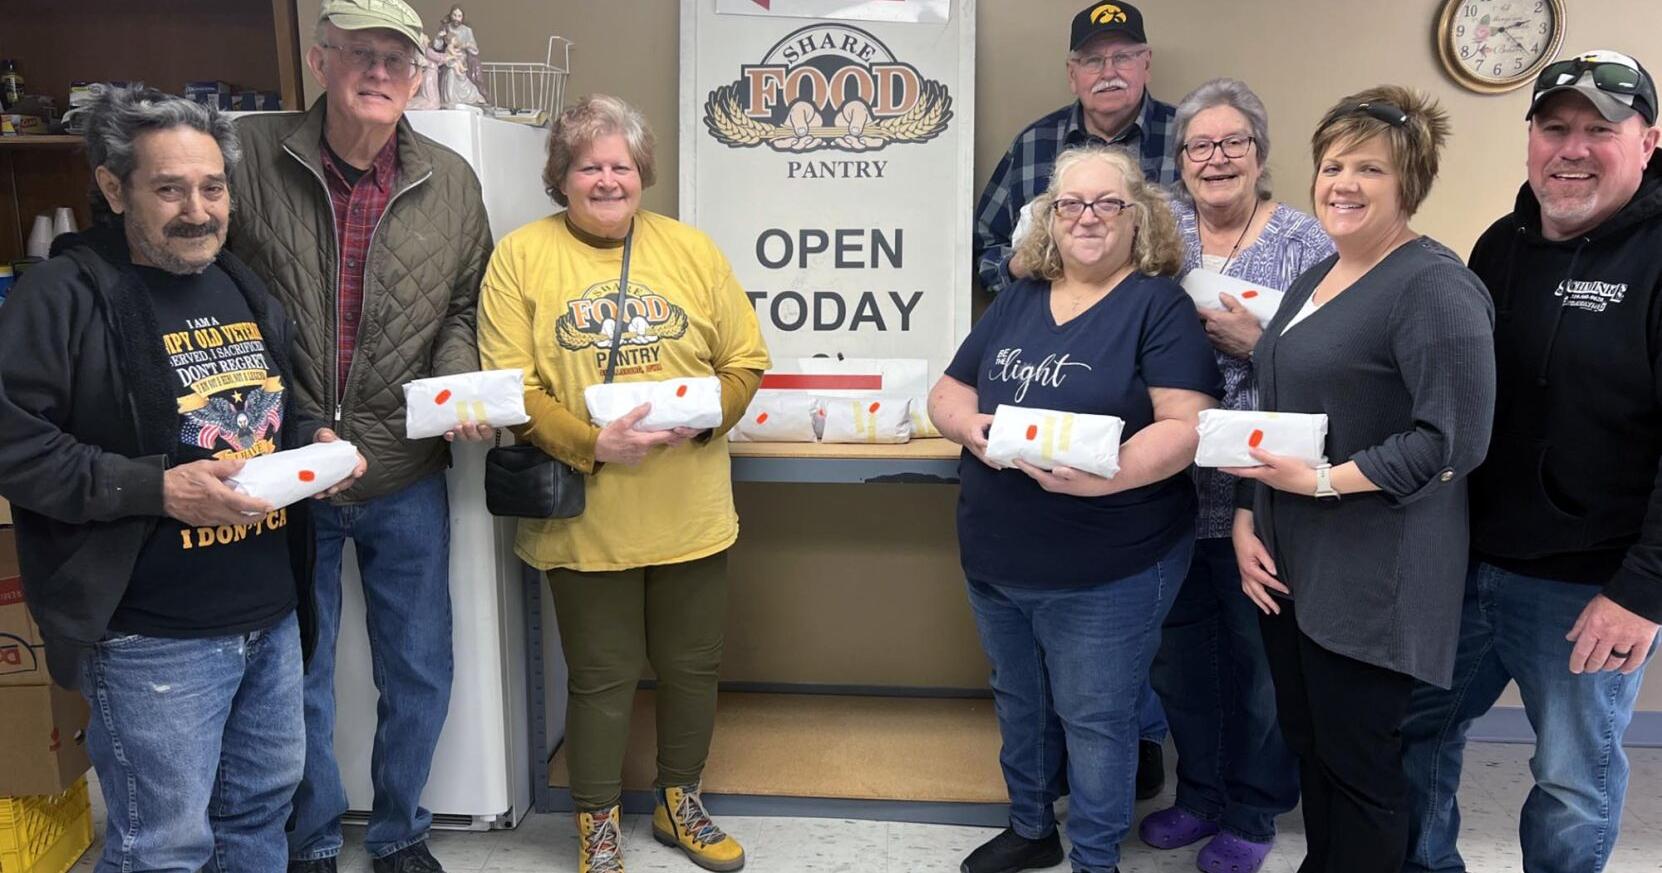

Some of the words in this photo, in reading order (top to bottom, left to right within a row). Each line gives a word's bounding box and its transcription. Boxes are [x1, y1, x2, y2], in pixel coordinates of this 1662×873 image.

[1464, 4, 1478, 17] 10
[1534, 1, 1543, 13] 2
[1456, 25, 1465, 37] 9
[1538, 23, 1548, 34] 3
[782, 32, 876, 64] SHARE
[1460, 45, 1469, 58] 8
[1530, 42, 1539, 54] 4
[1475, 59, 1484, 71] 7
[1493, 63, 1502, 76] 6
[1514, 58, 1523, 69] 5
[744, 65, 920, 117] FOOD
[787, 160, 888, 178] PANTRY
[756, 228, 903, 269] OPEN
[571, 295, 671, 329] FOOD
[186, 319, 194, 329] I
[194, 316, 211, 328] AM
[211, 315, 220, 326] A
[194, 327, 223, 349] OLD
[209, 348, 217, 359] I
[997, 348, 1010, 358] BE
[176, 361, 218, 387] DON'T
[988, 348, 1092, 403] light
[180, 529, 193, 549] I
